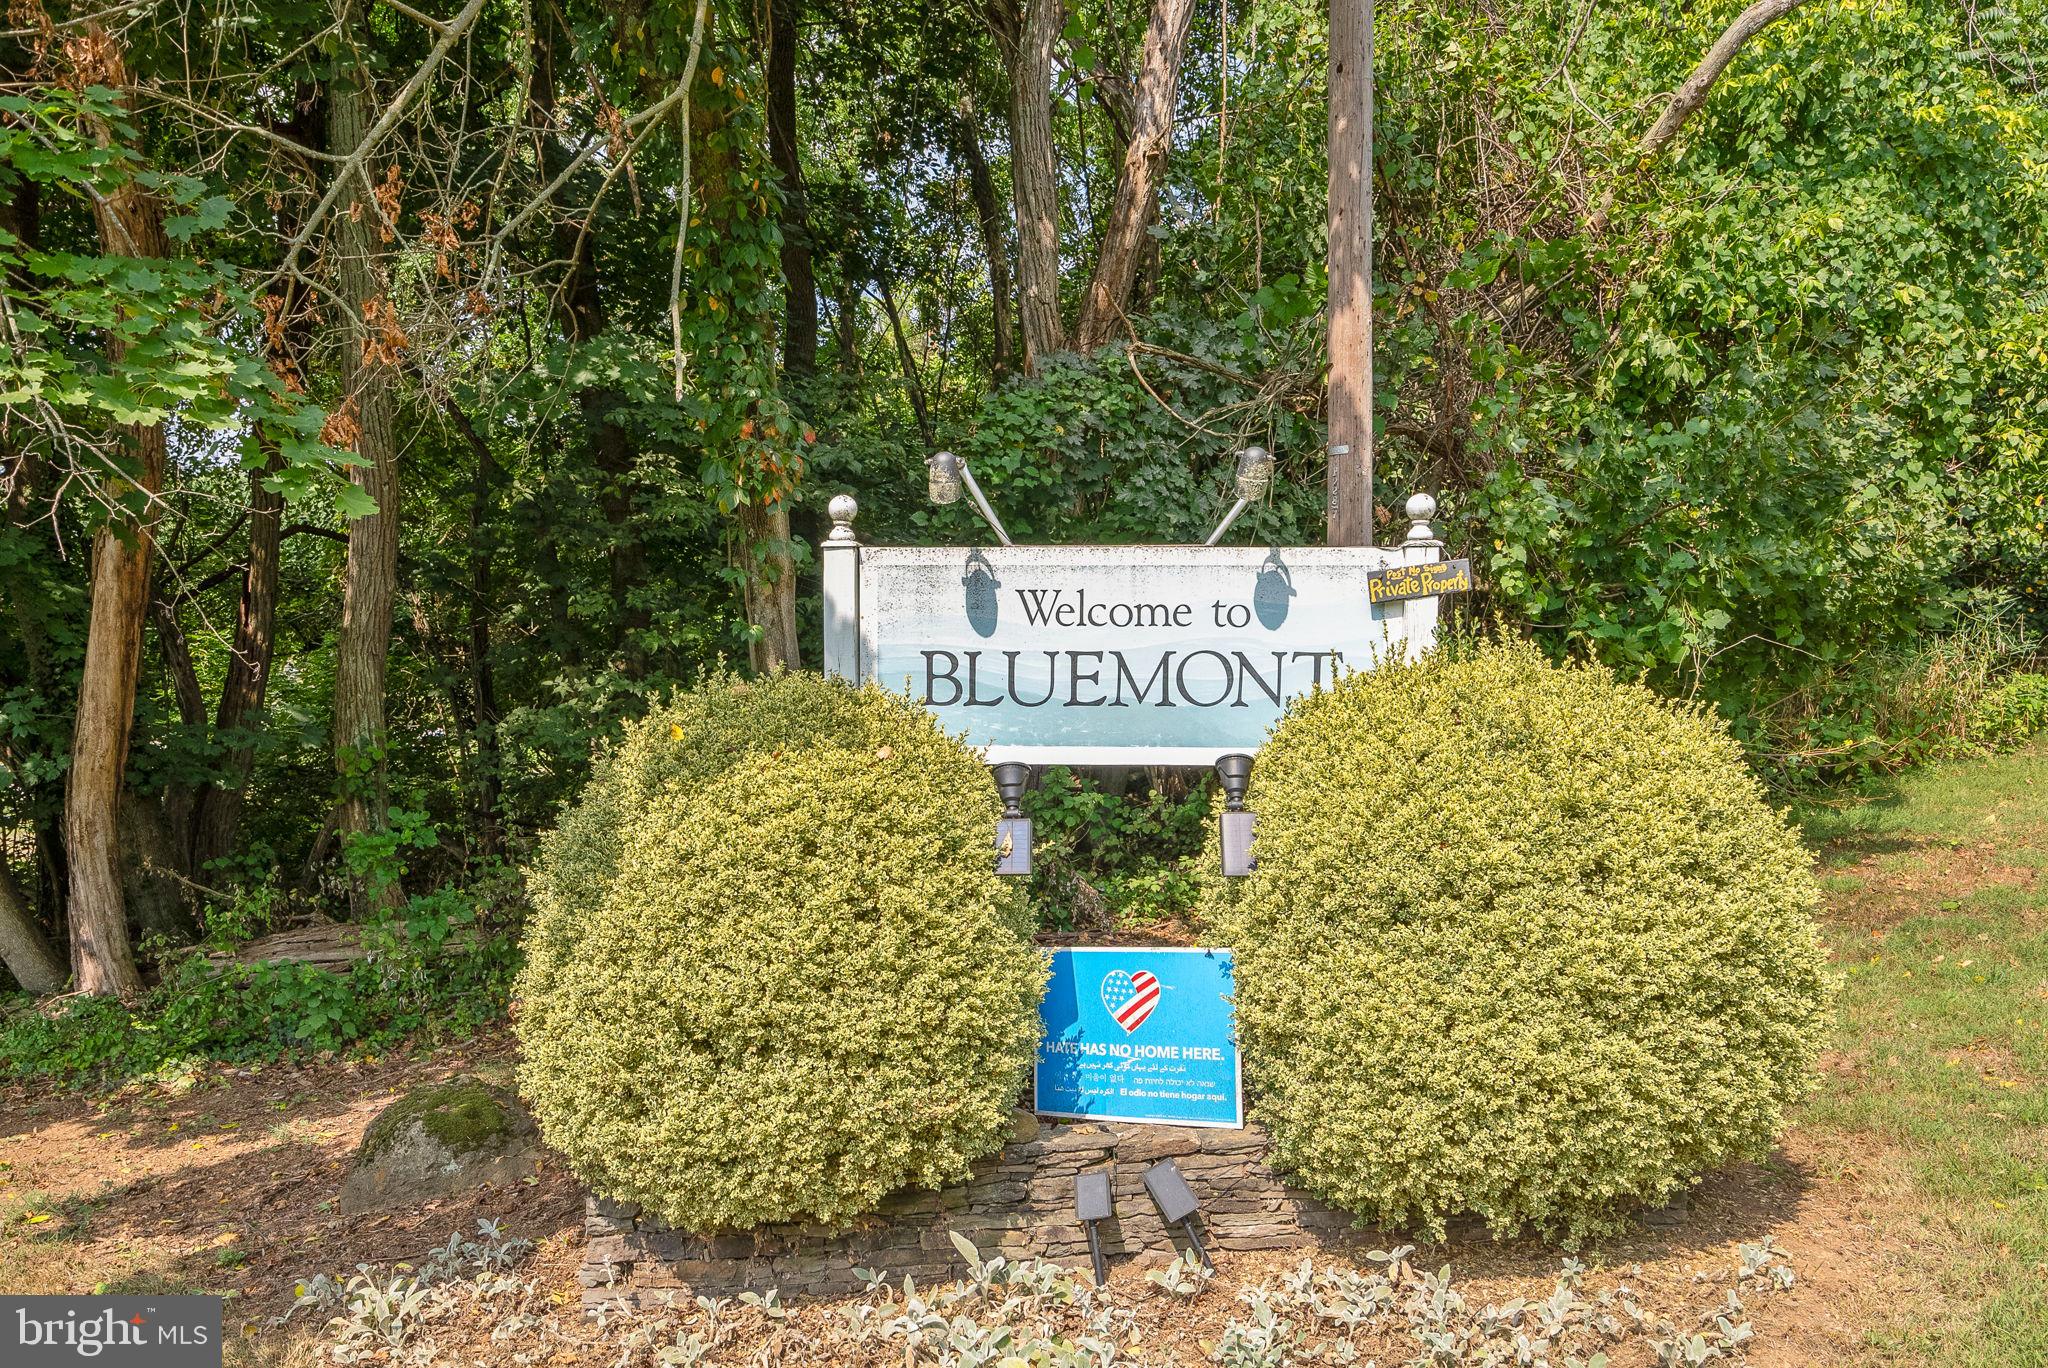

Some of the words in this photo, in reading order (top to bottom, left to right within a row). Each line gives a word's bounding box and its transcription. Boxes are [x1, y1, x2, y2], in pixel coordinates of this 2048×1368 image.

[1386, 567, 1406, 579] Post
[1408, 565, 1421, 575] No
[1369, 576, 1420, 602] Private
[1421, 570, 1468, 595] Property
[1015, 589, 1193, 627] Welcome
[1213, 597, 1252, 628] to
[919, 650, 1344, 708] BLUEMONT
[1046, 1041, 1078, 1054] HATE
[1080, 1042, 1107, 1056] HAS
[1109, 1043, 1132, 1057] NO
[1134, 1044, 1179, 1059] HOME
[1182, 1046, 1225, 1061] HERE.
[1120, 1088, 1127, 1096] El
[1128, 1088, 1147, 1097] odio
[1159, 1090, 1180, 1099] tiene
[1181, 1091, 1205, 1101] hogar
